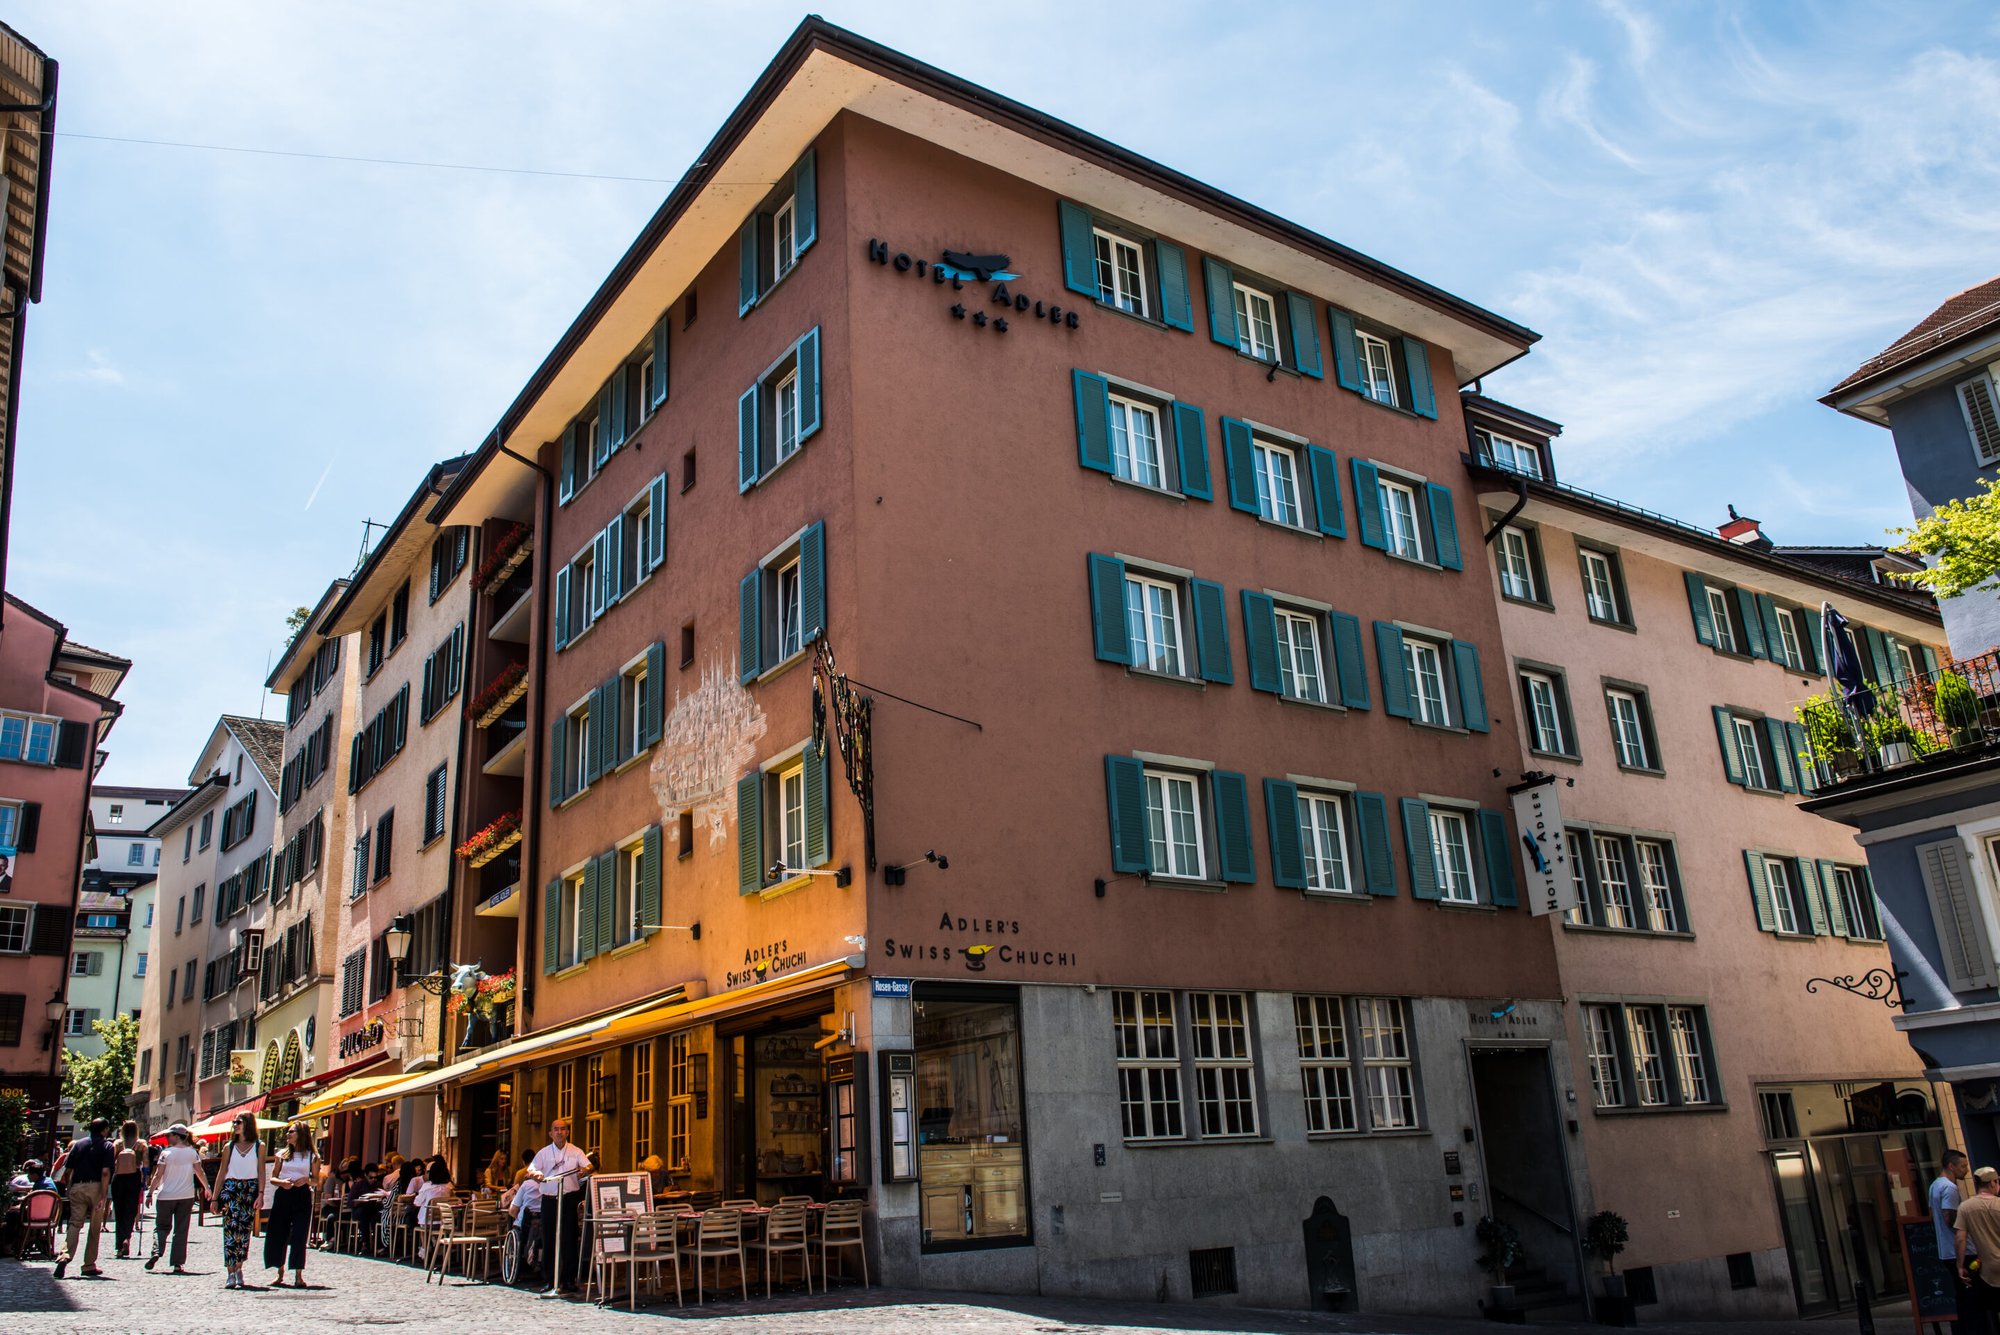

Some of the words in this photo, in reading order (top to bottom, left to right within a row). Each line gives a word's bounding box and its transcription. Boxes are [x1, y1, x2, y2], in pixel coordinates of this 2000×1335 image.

[869, 238, 963, 290] HOTEL
[992, 282, 1079, 329] ADLER
[1531, 792, 1547, 842] ADLER
[1543, 859, 1558, 910] HOTEL
[939, 911, 1020, 934] ADLER'S
[744, 939, 787, 965] ADLER'S
[885, 939, 951, 961] SWISS
[999, 939, 1076, 966] CHUCHI
[727, 969, 751, 987] SWISS
[772, 951, 806, 973] CHUCHI
[875, 980, 908, 992] Rosen-Gasse
[1508, 1013, 1537, 1025] ADLER
